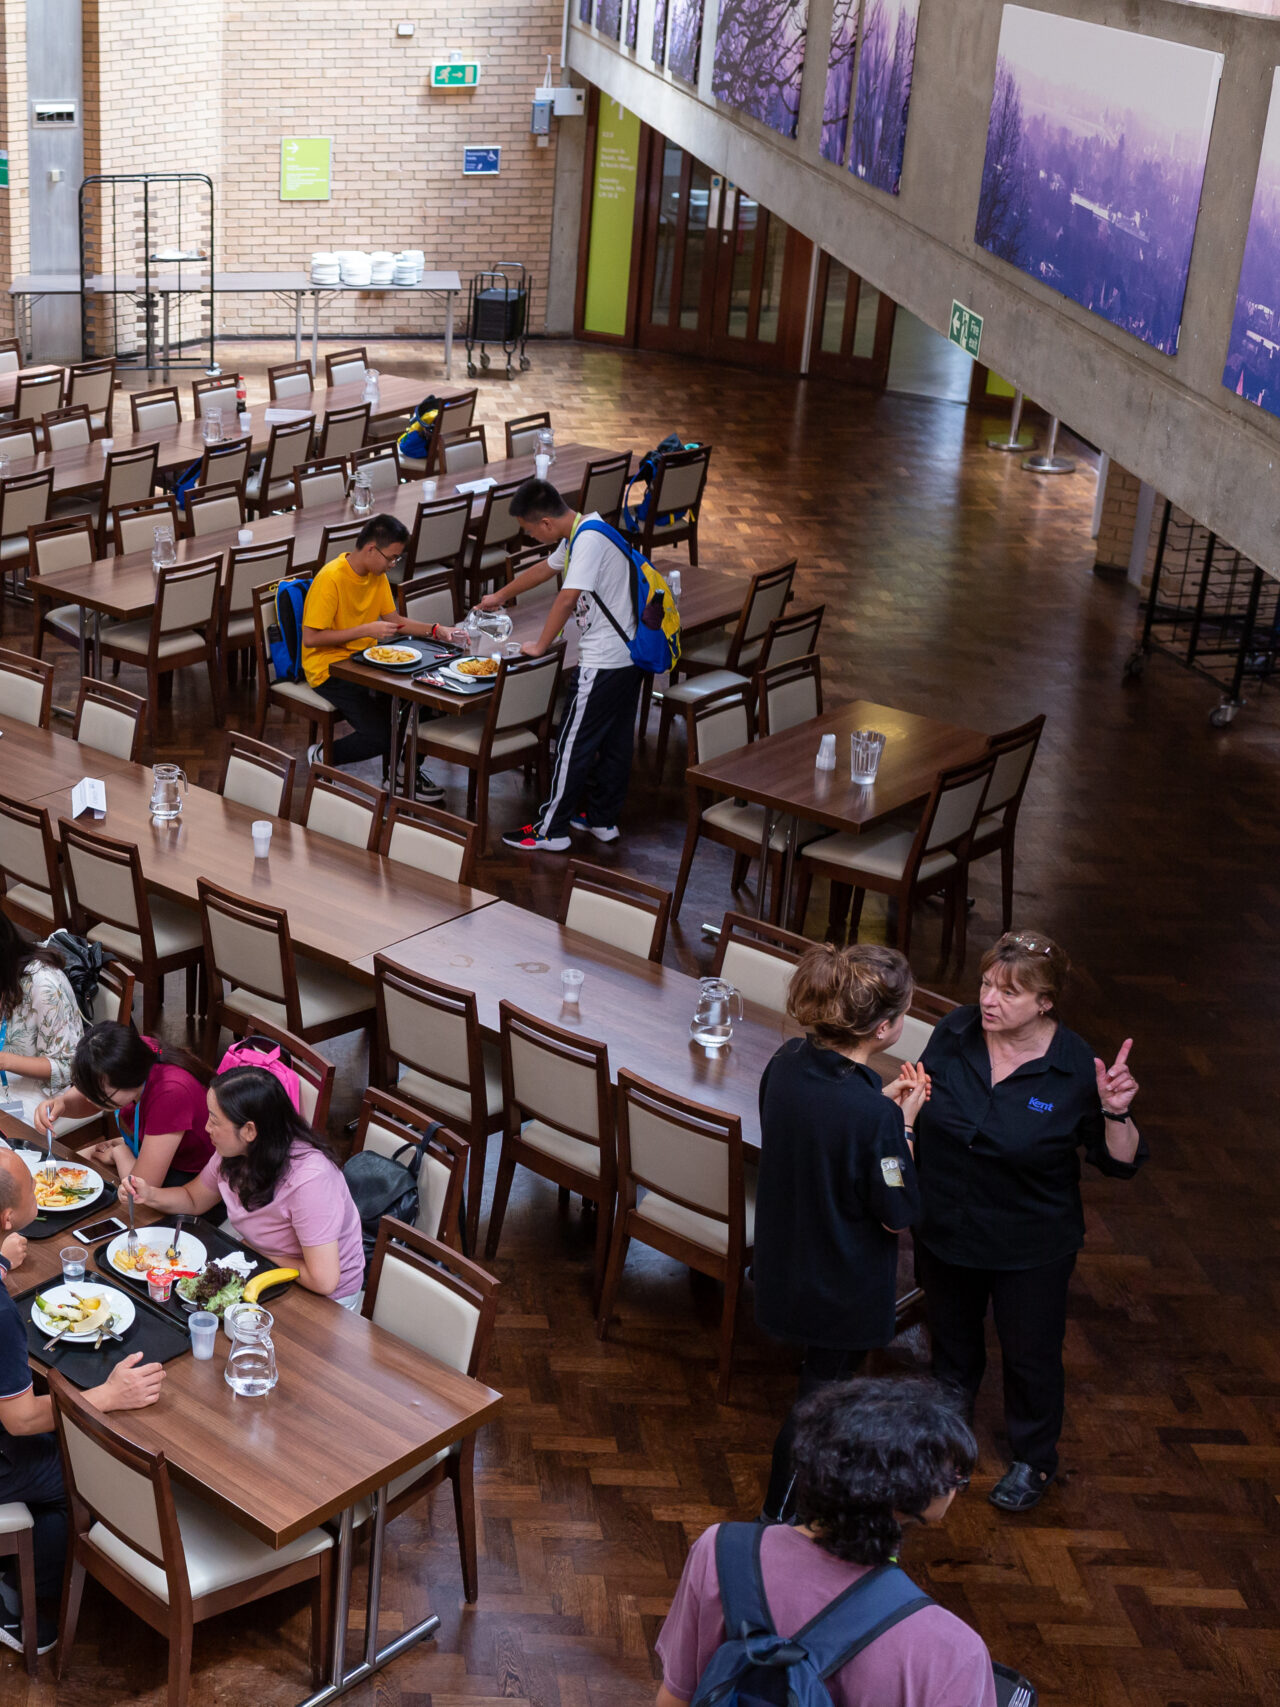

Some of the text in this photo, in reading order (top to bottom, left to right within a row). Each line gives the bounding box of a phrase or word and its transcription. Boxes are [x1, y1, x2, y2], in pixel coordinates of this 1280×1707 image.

[970, 320, 979, 336] Fire
[968, 337, 978, 350] exit
[1028, 1096, 1053, 1112] Kent
